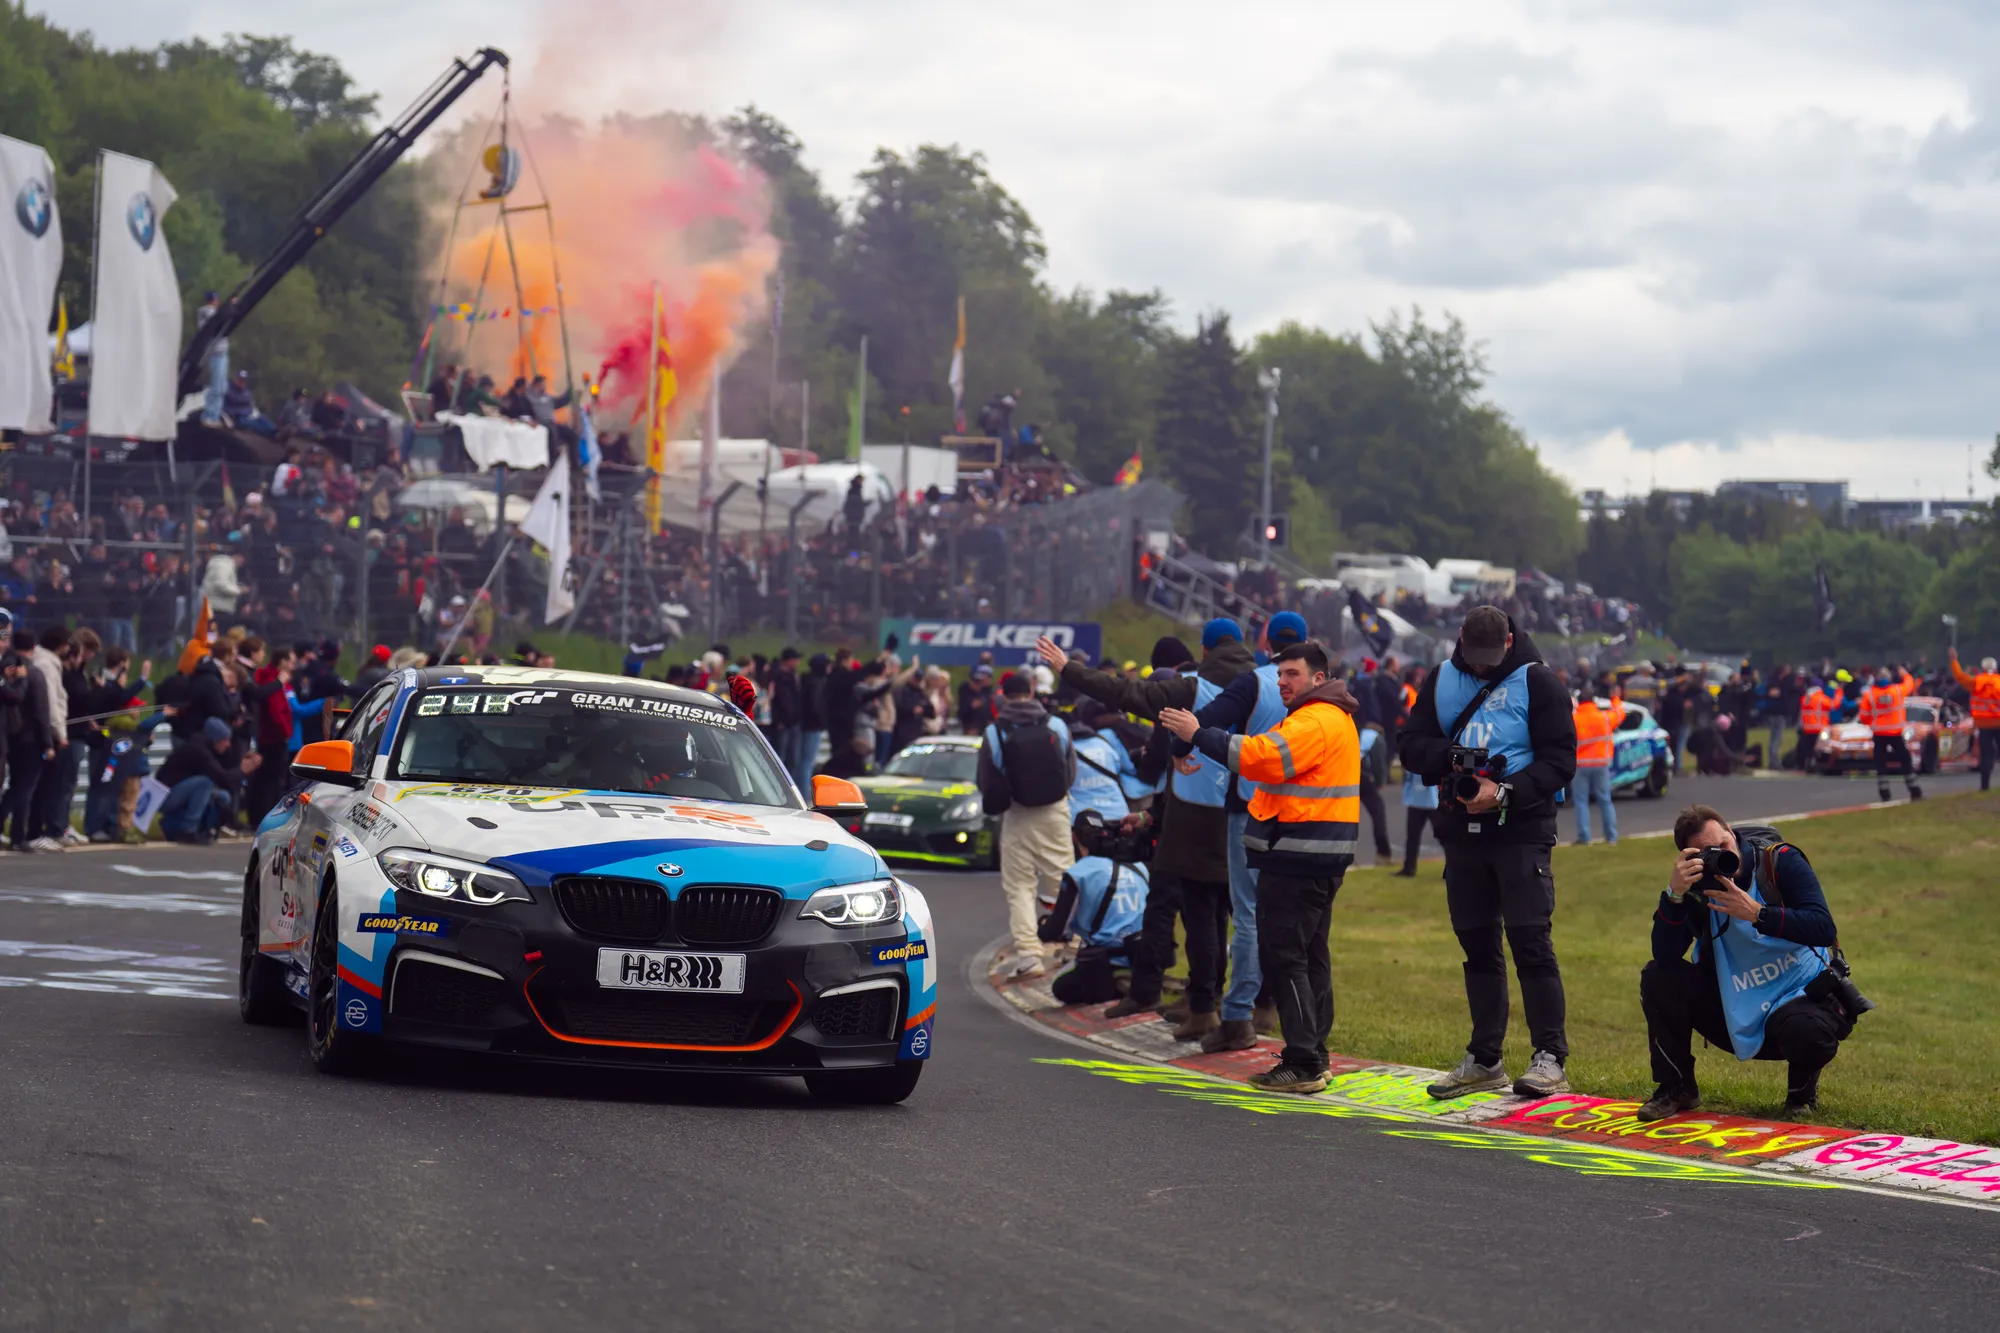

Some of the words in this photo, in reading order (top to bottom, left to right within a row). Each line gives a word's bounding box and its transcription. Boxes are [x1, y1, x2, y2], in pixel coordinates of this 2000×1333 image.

[908, 622, 1076, 648] FALKEN
[417, 693, 512, 716] 24H
[571, 693, 634, 708] GRAN
[641, 699, 738, 726] TURISMO
[629, 708, 673, 719] DRIVING
[676, 715, 737, 731] SIMULATOR
[630, 813, 771, 836] race
[1113, 892, 1140, 914] TV
[364, 916, 439, 932] GOODYEAR
[878, 943, 926, 961] GOODYEAR
[620, 953, 688, 987] H&R
[1731, 952, 1798, 993] MEDIA
